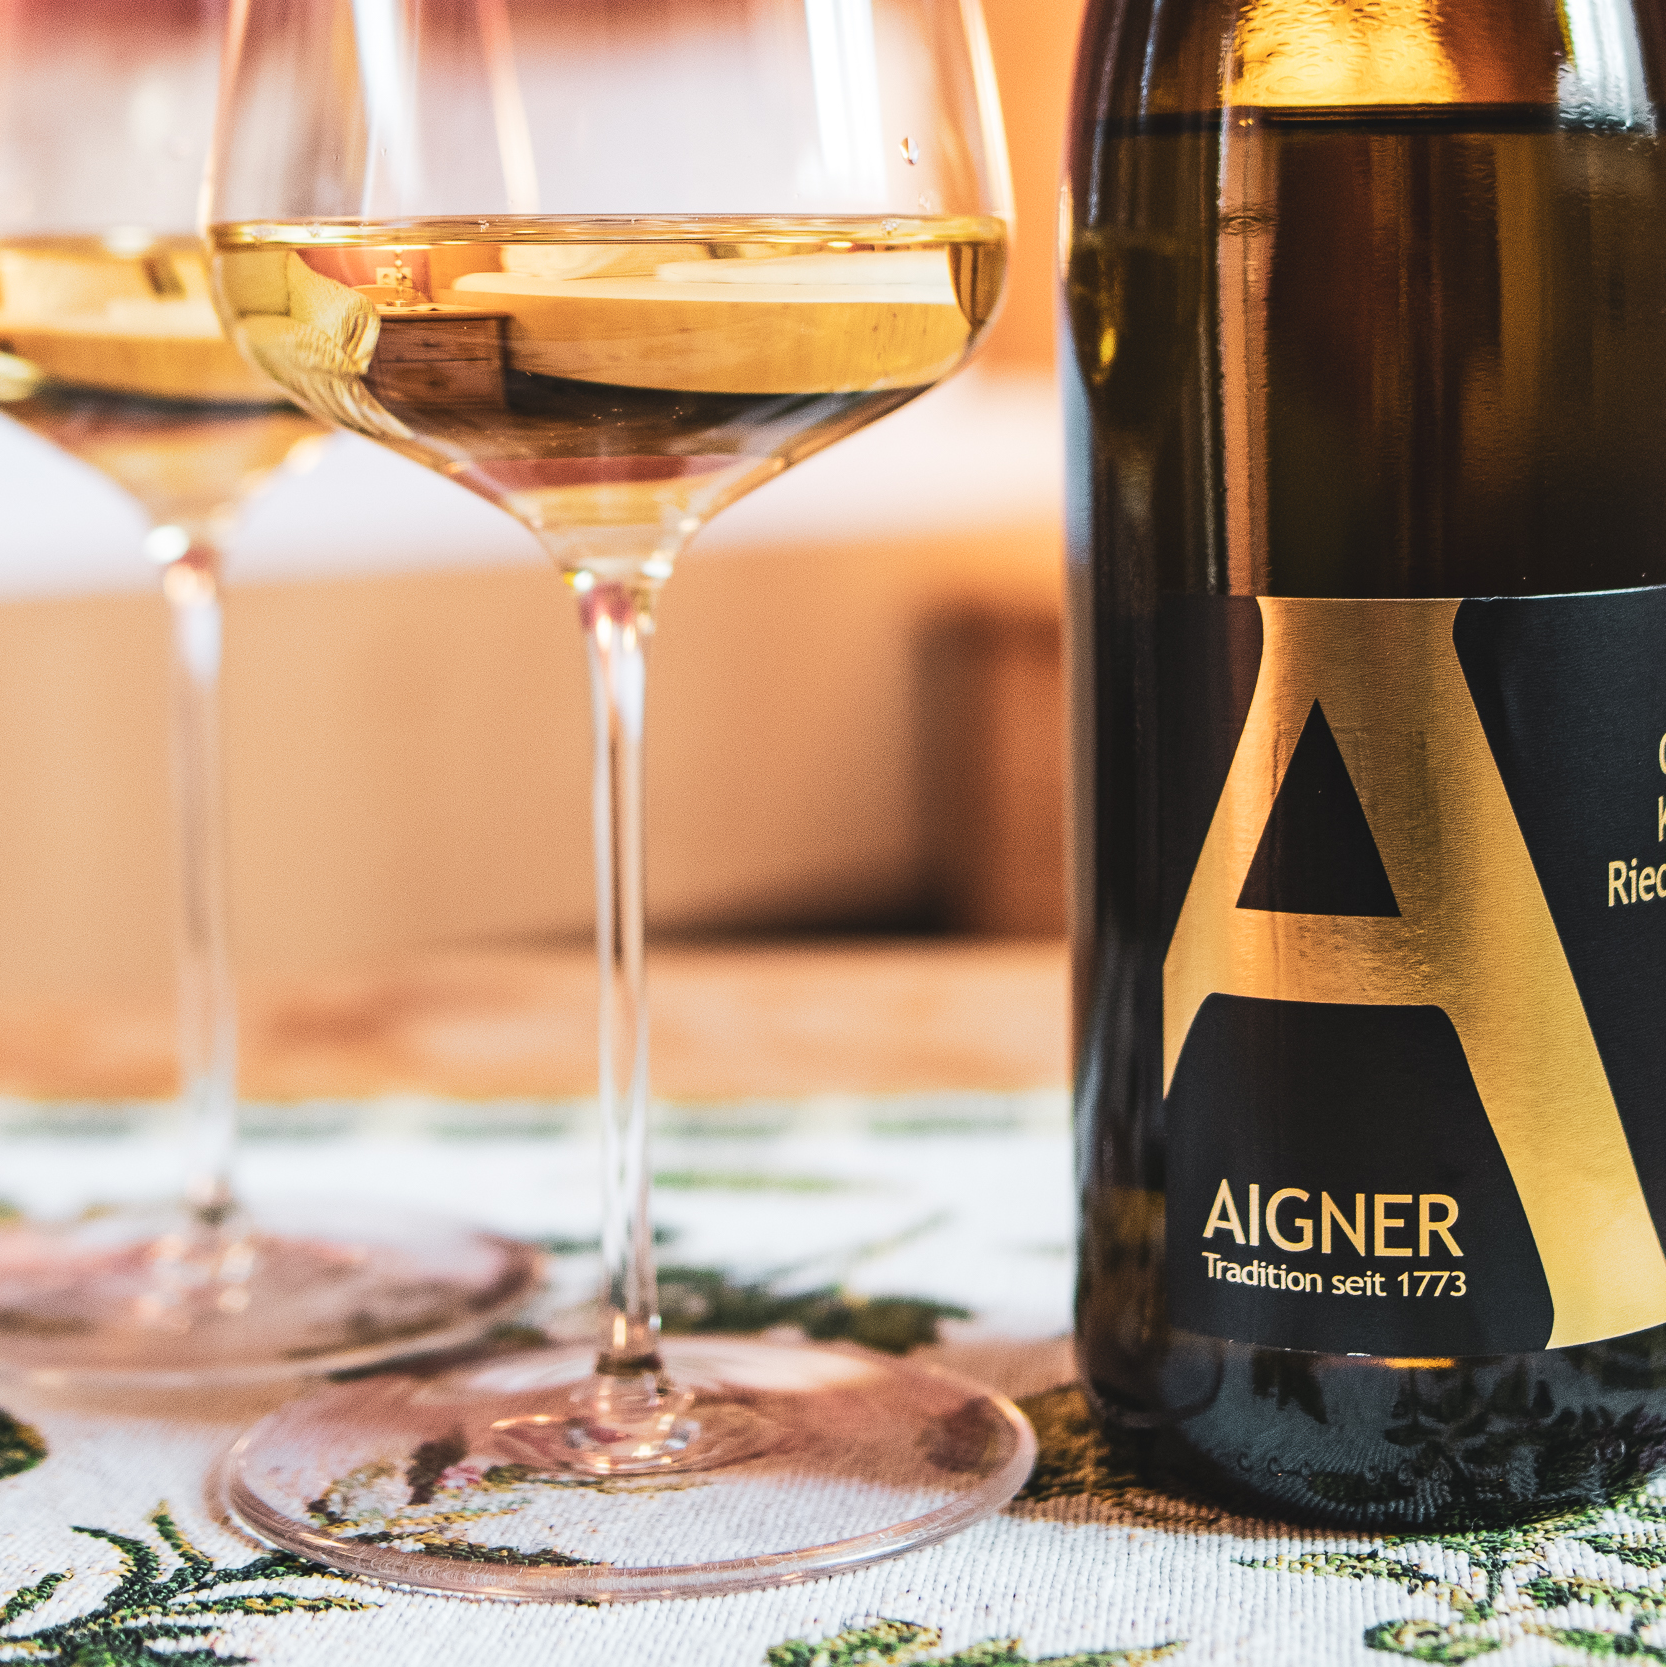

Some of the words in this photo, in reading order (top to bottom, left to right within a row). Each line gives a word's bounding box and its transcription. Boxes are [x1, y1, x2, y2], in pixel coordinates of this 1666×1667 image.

[1201, 1178, 1465, 1257] AIGNER
[1201, 1251, 1323, 1294] Tradition
[1331, 1270, 1387, 1297] seit
[1396, 1270, 1467, 1297] 1773
